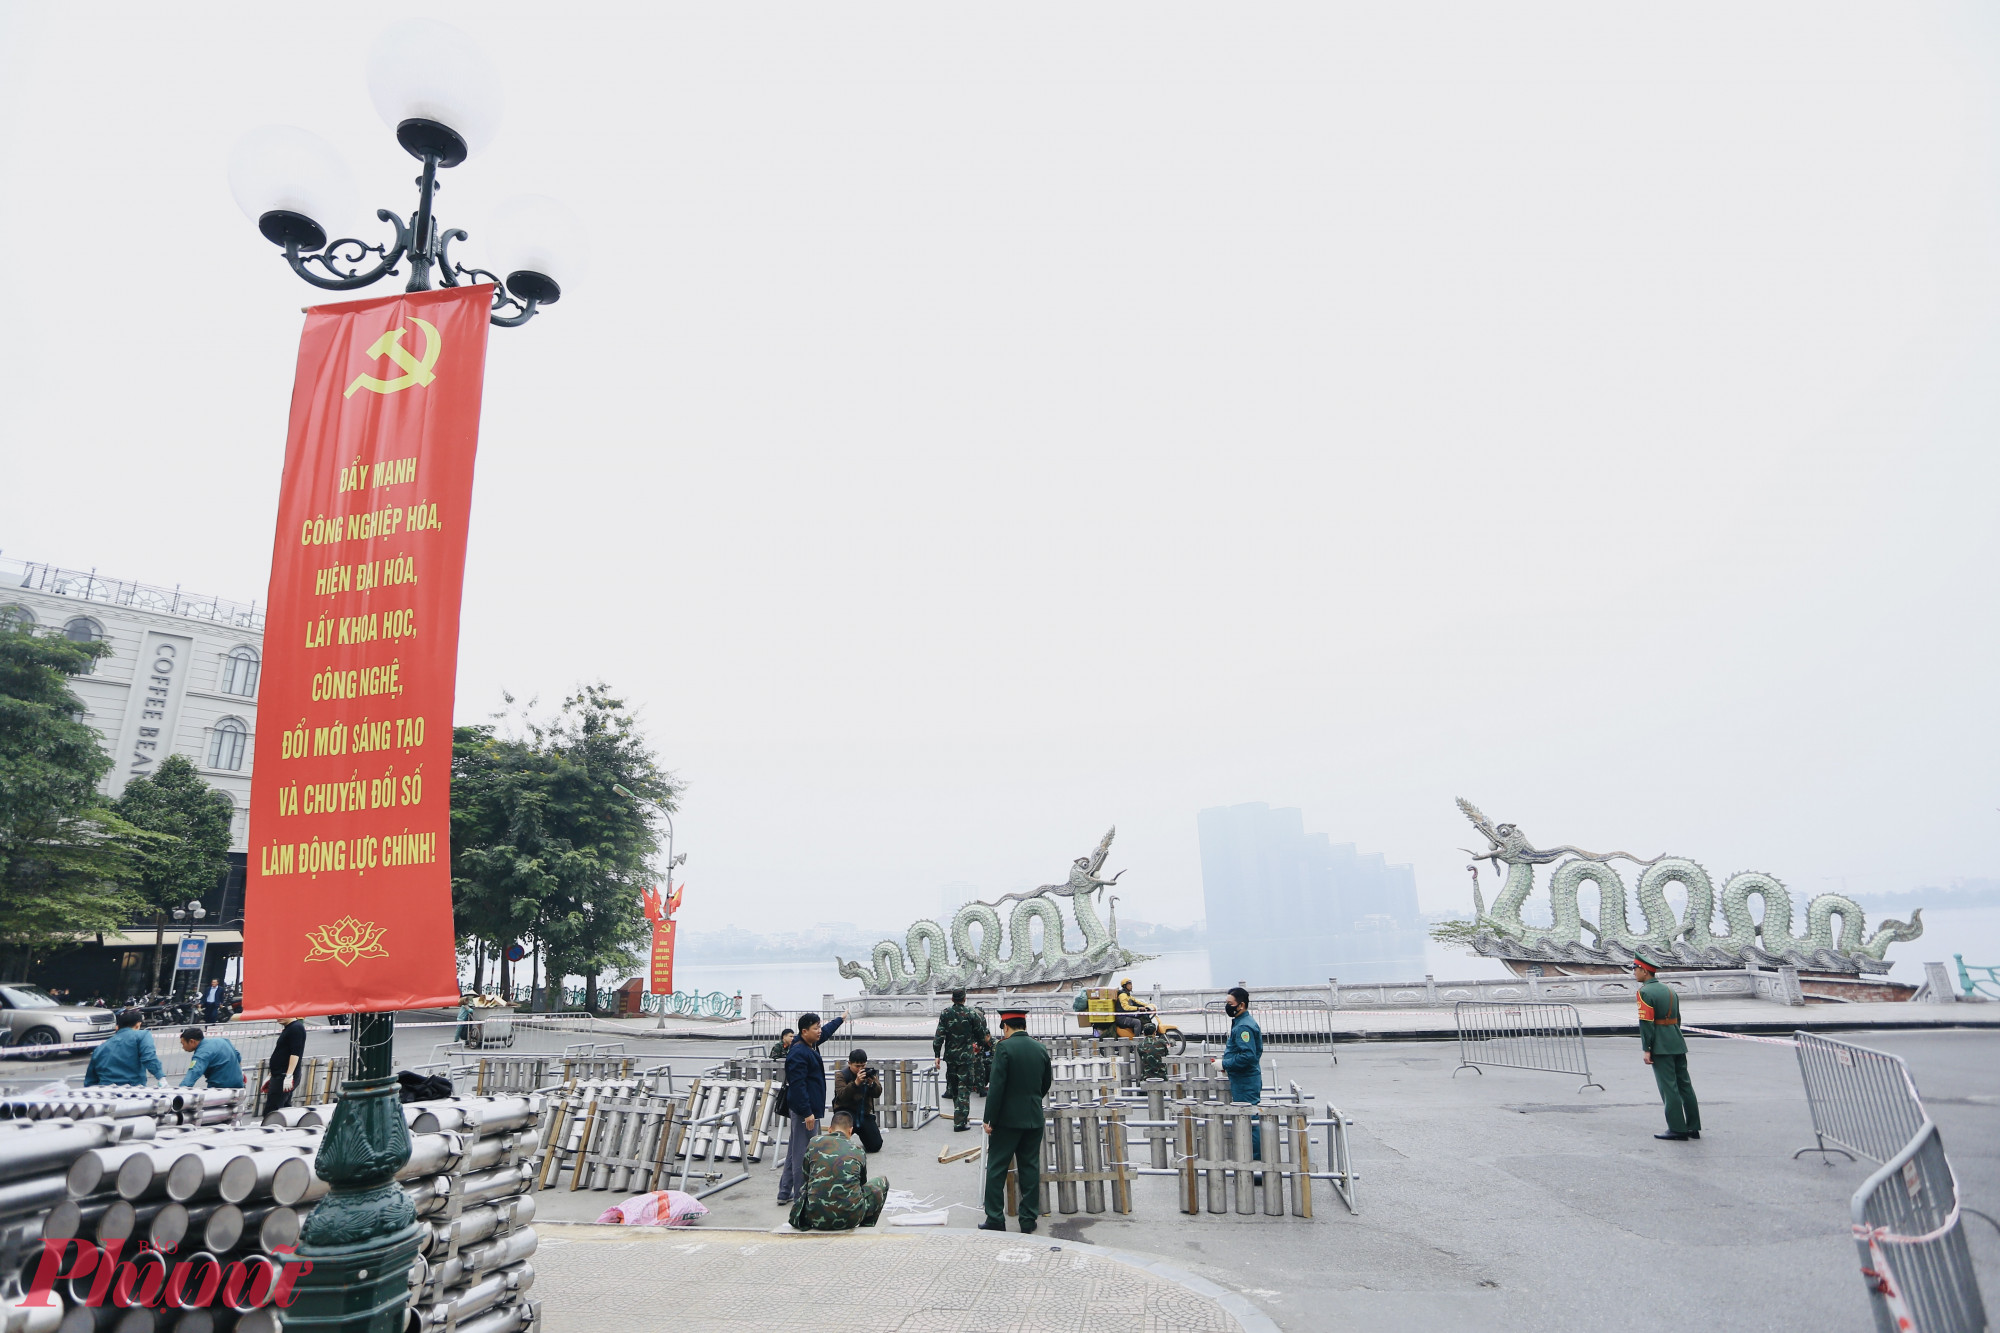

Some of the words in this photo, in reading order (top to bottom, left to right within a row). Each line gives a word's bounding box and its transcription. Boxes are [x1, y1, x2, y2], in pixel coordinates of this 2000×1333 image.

[340, 455, 369, 493] ĐẨY
[373, 457, 416, 492] MẠNH
[302, 514, 343, 546] CÔNG
[347, 504, 402, 541] NGHIỆP
[406, 499, 442, 532] HÓA,
[315, 561, 352, 600] HIỆN
[356, 561, 380, 595] ĐẠI
[384, 552, 418, 587] HÓA,
[305, 610, 335, 648] LẤY
[338, 614, 378, 645] KHOA
[383, 608, 417, 644] HỌC,
[142, 643, 177, 720] COFFEE
[312, 666, 358, 701] CÔNG
[360, 658, 403, 700] NGHỆ,
[282, 717, 310, 760] ĐỔI
[313, 720, 348, 757] MỚI
[352, 717, 391, 754] SÁNG
[396, 717, 425, 755] TẠO
[279, 779, 299, 817] VÀ
[303, 768, 367, 815] CHUYỂN
[371, 764, 397, 809] ĐỔI
[401, 763, 423, 806] SỐ
[262, 838, 295, 877] LÀM
[299, 836, 347, 880] ĐỘNG
[350, 833, 378, 876] LỰC
[382, 827, 437, 868] CHÍNH!
